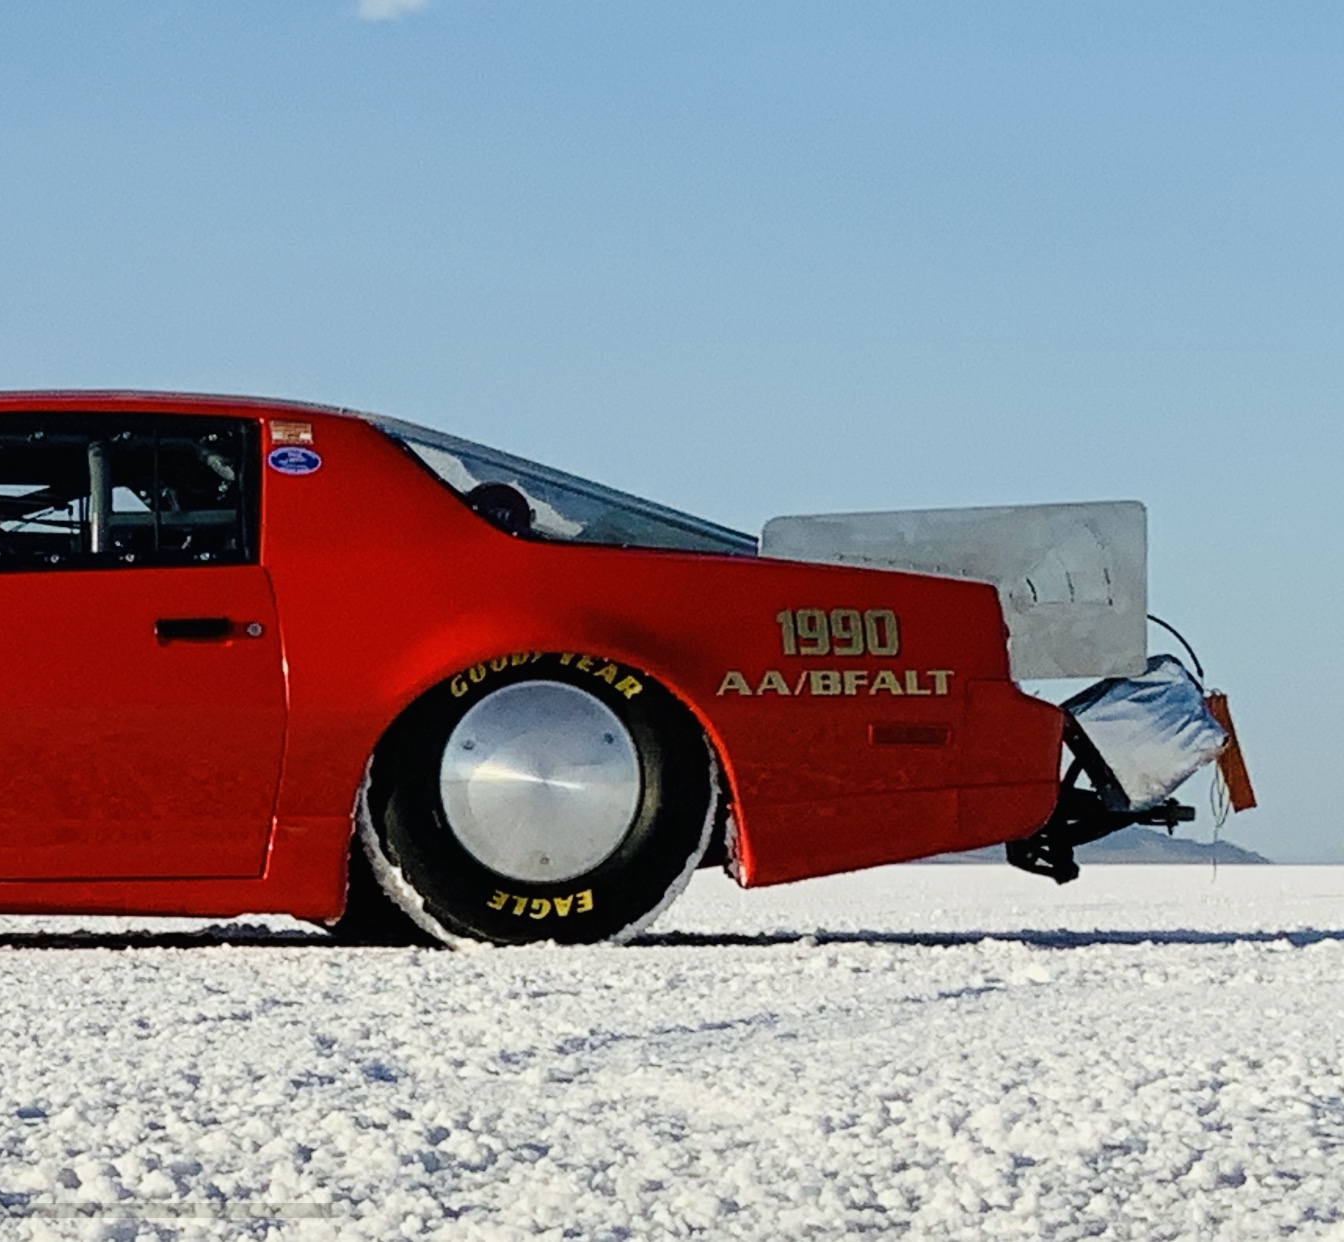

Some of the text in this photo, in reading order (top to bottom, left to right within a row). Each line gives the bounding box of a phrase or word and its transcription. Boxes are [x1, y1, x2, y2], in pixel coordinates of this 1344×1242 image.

[776, 608, 900, 656] 1990
[716, 669, 956, 697] AA/BFALT
[486, 888, 595, 920] EAGLE
